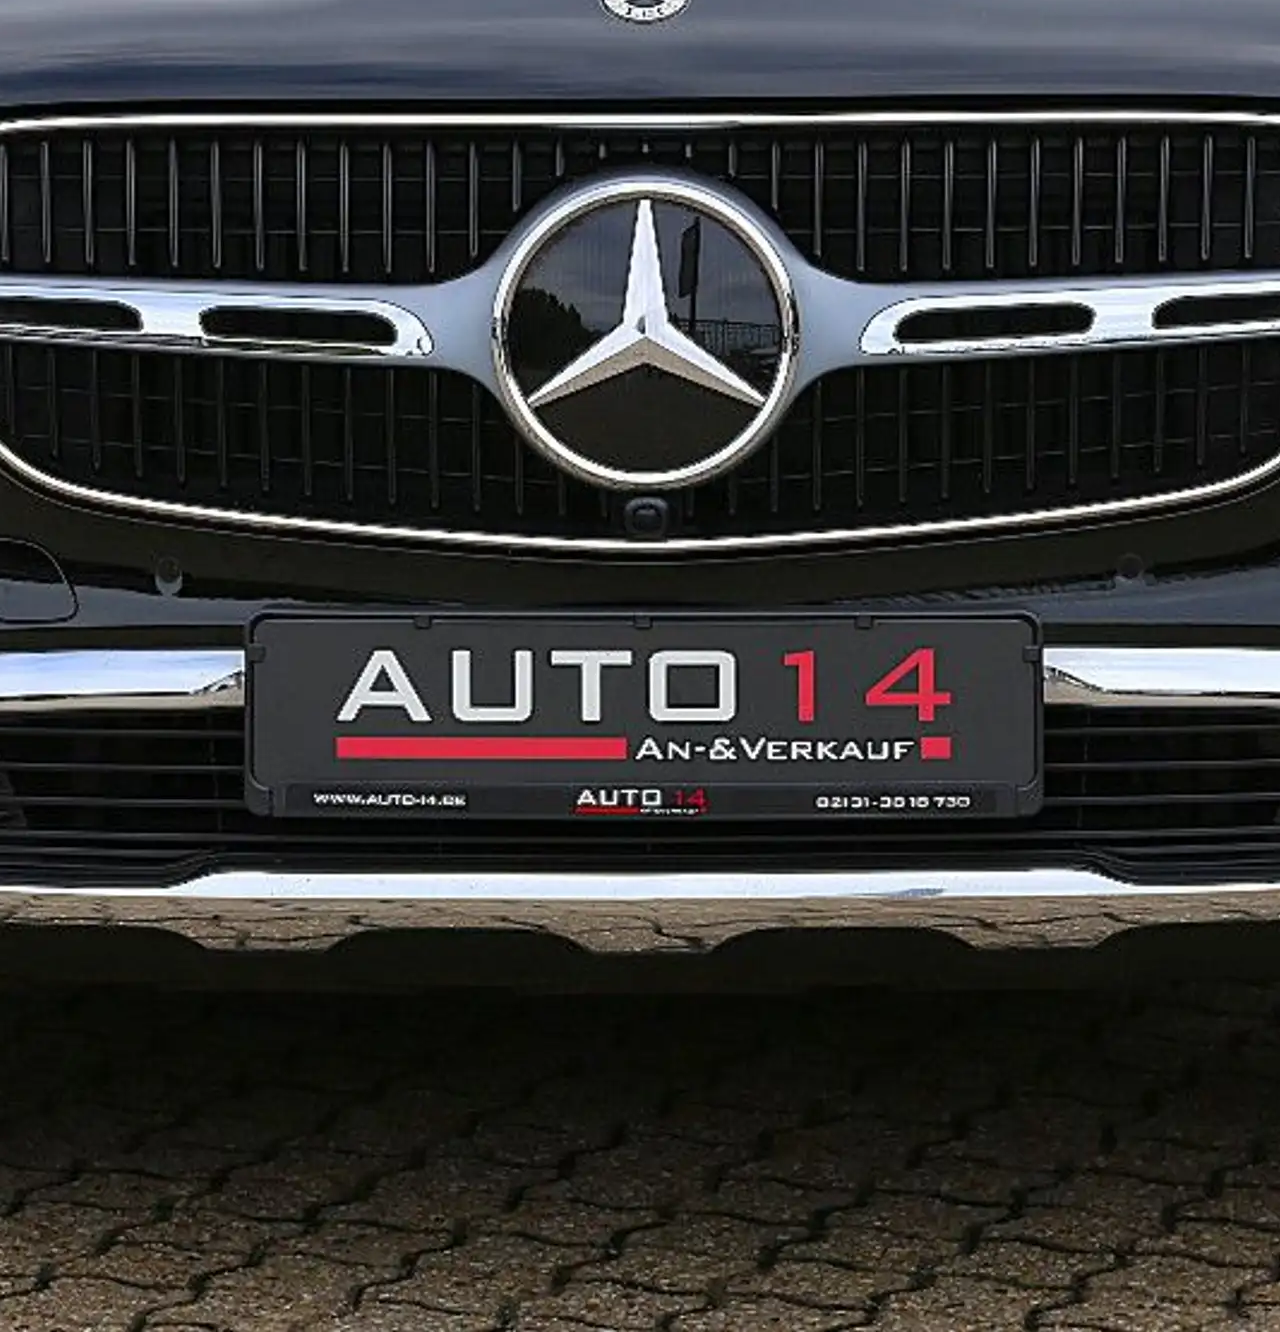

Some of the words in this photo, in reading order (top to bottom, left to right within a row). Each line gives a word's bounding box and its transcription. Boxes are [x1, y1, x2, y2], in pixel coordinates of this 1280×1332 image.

[336, 649, 736, 722] AUTO
[783, 647, 952, 722] 14
[576, 789, 662, 806] AUTO
